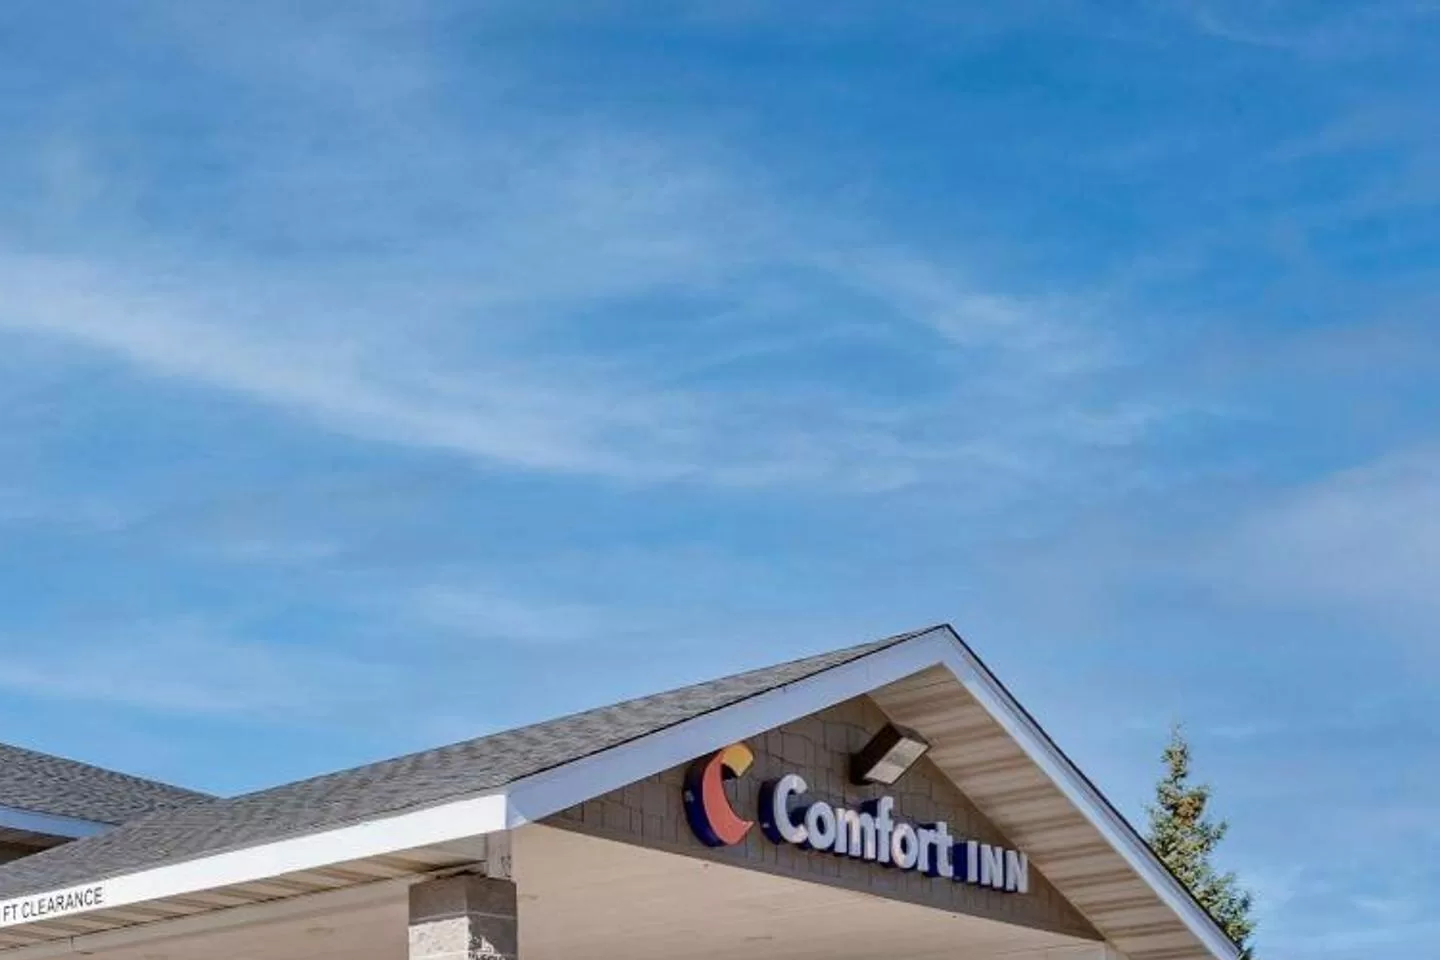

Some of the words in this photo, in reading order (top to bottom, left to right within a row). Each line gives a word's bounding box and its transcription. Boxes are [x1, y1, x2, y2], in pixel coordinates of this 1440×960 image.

[769, 773, 953, 877] Comfort
[965, 840, 1028, 893] INN
[4, 904, 18, 922] FT
[21, 887, 103, 918] CLEARANCE
